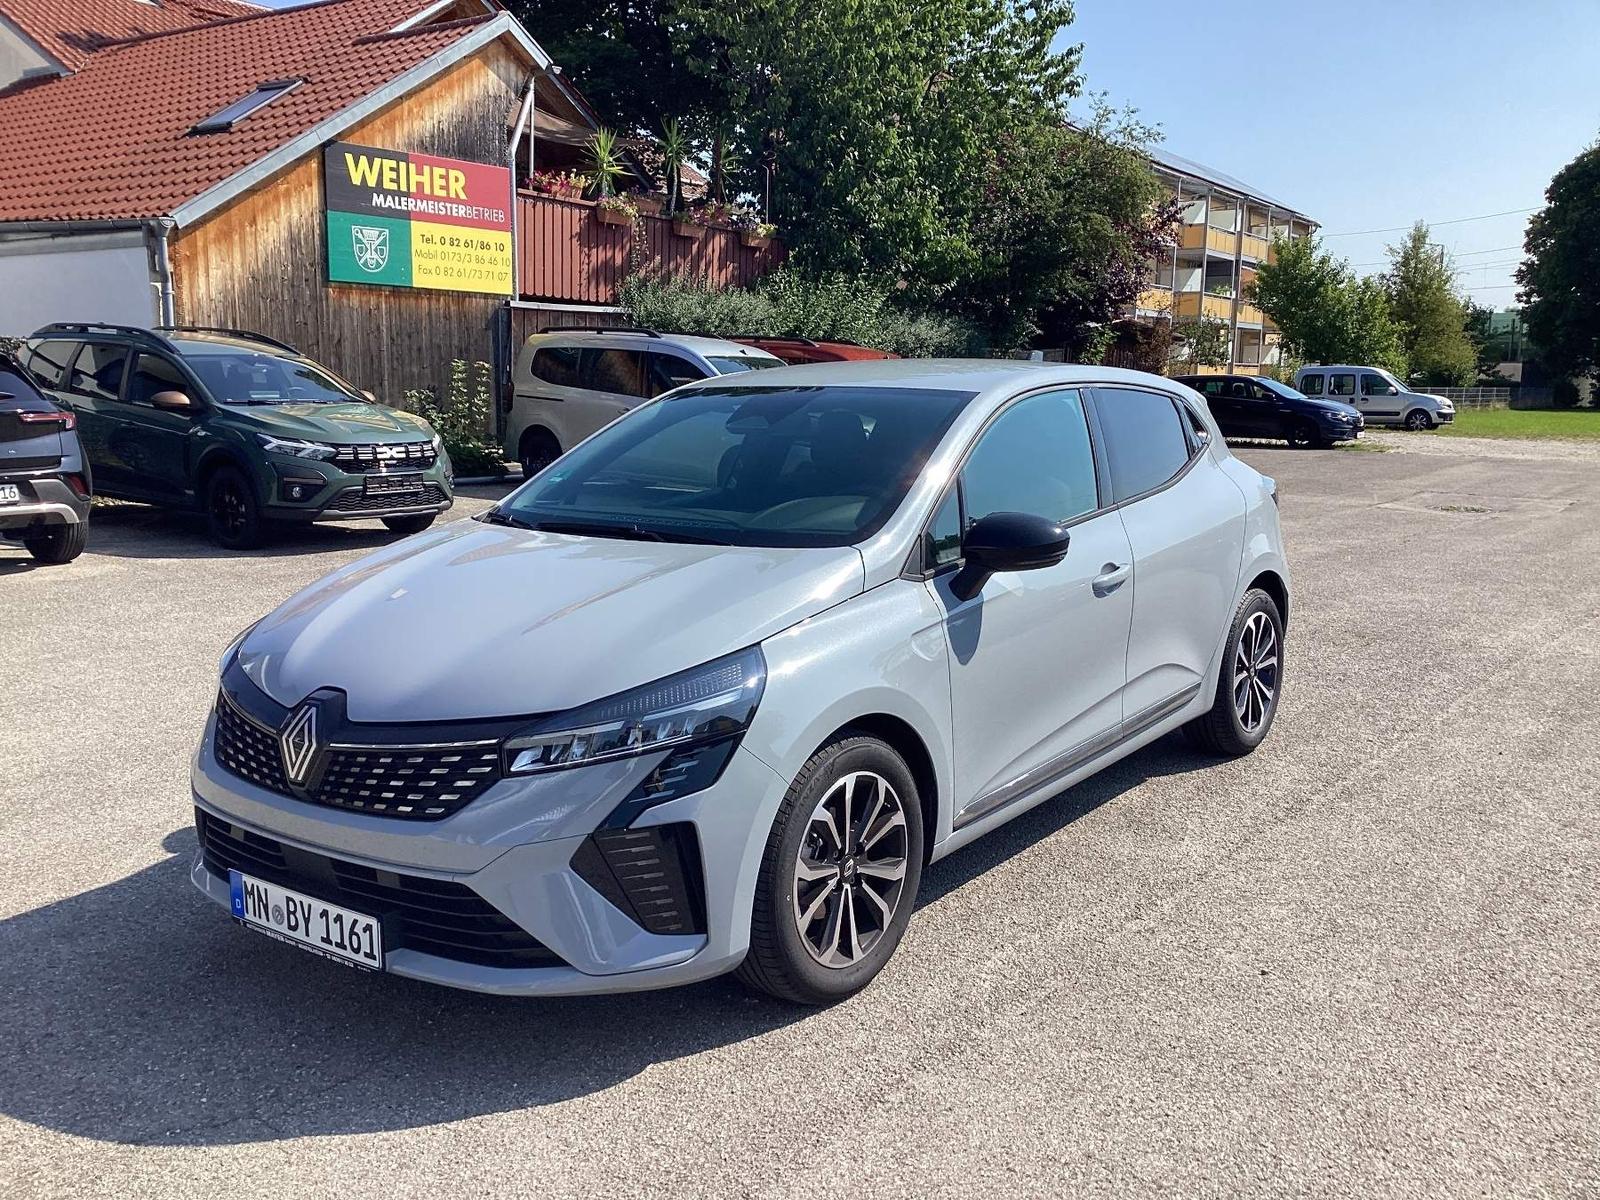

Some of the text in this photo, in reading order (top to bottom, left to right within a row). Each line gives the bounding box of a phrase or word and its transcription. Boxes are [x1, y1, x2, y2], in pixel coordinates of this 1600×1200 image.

[345, 153, 467, 200] WEIHER
[372, 193, 505, 222] MALERMEISTERBETRIEB
[420, 234, 504, 251] Tel. 0 82 61/86 10
[415, 249, 510, 267] Mobil 0173/3 86 46 10
[418, 265, 508, 281] Fax 0 82 61/73 71 07
[236, 898, 241, 908] D
[243, 881, 377, 961] MN BY 1161
